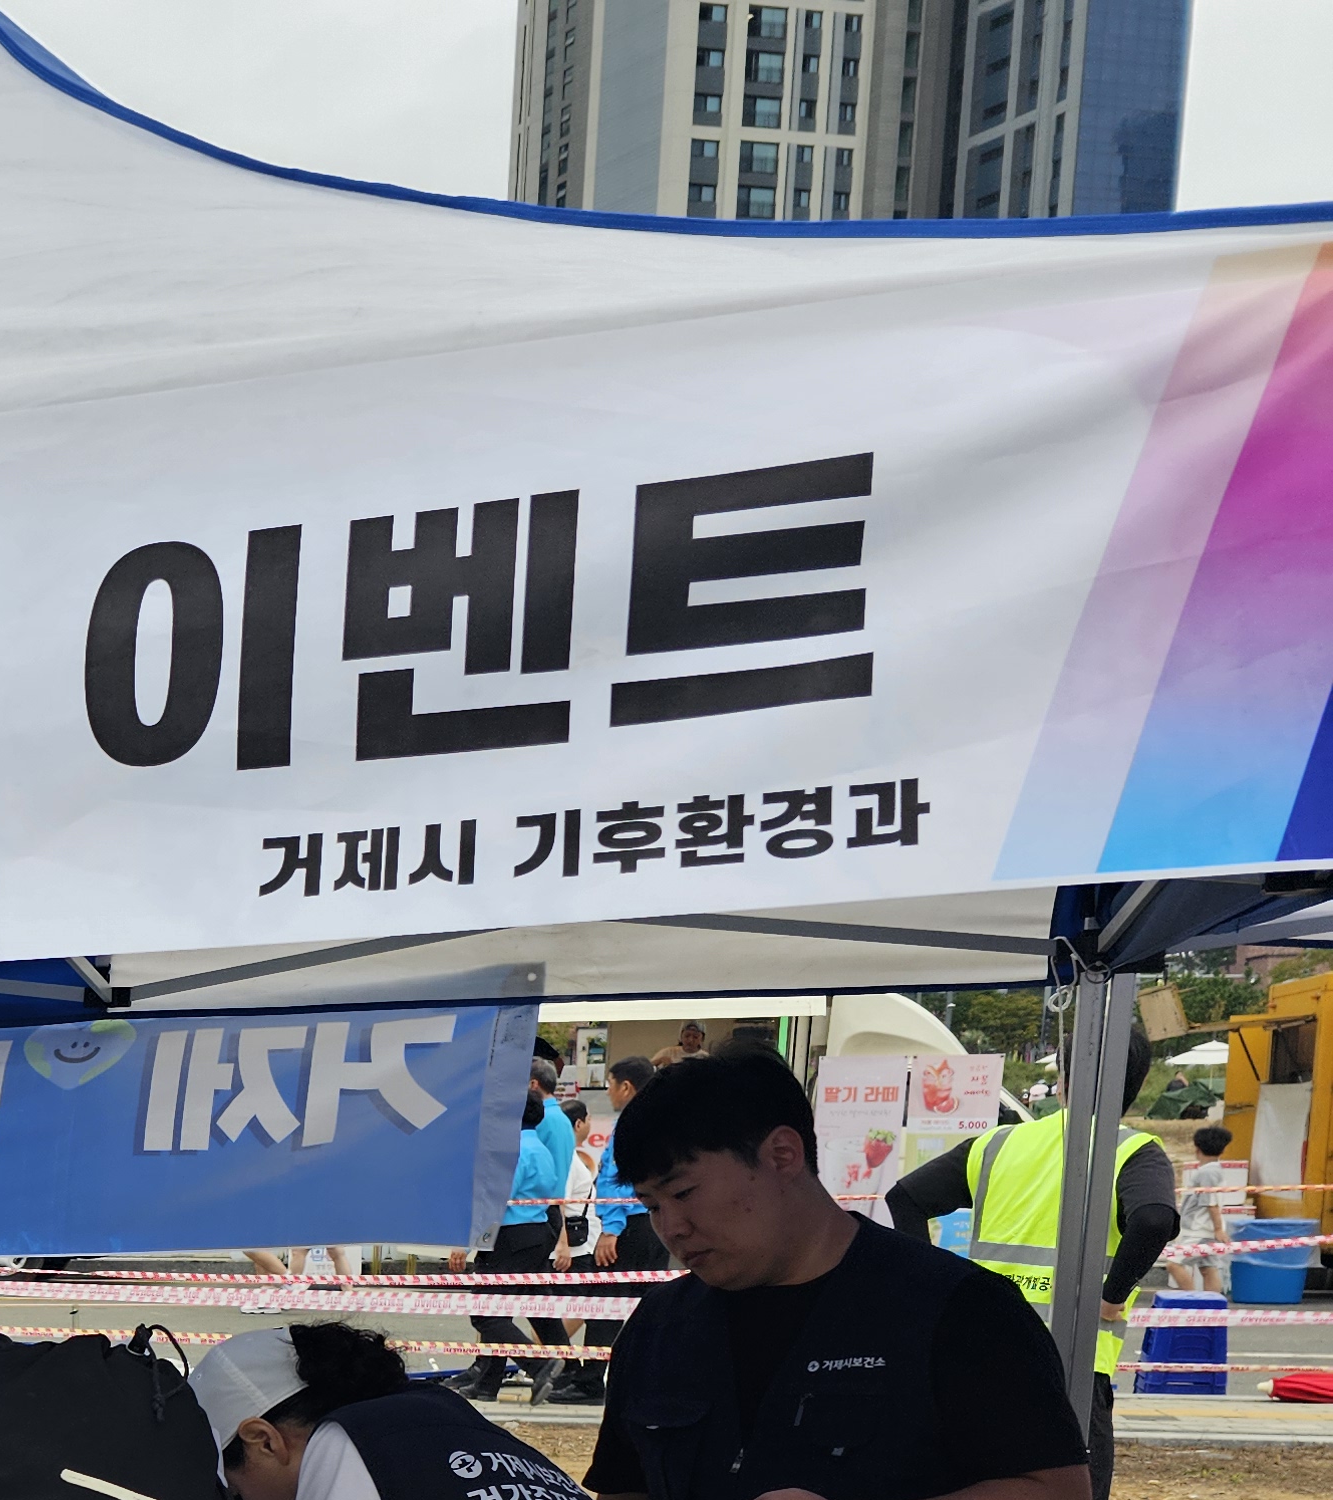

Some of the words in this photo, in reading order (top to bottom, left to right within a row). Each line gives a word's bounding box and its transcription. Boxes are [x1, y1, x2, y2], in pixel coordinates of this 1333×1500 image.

[85, 452, 874, 771] 이벤트
[258, 818, 477, 899] 거제시
[515, 777, 931, 880] 기후환경과
[824, 1085, 858, 1104] 딸기
[864, 1085, 899, 1103] 라떼
[821, 1357, 886, 1371] 거제시보건소
